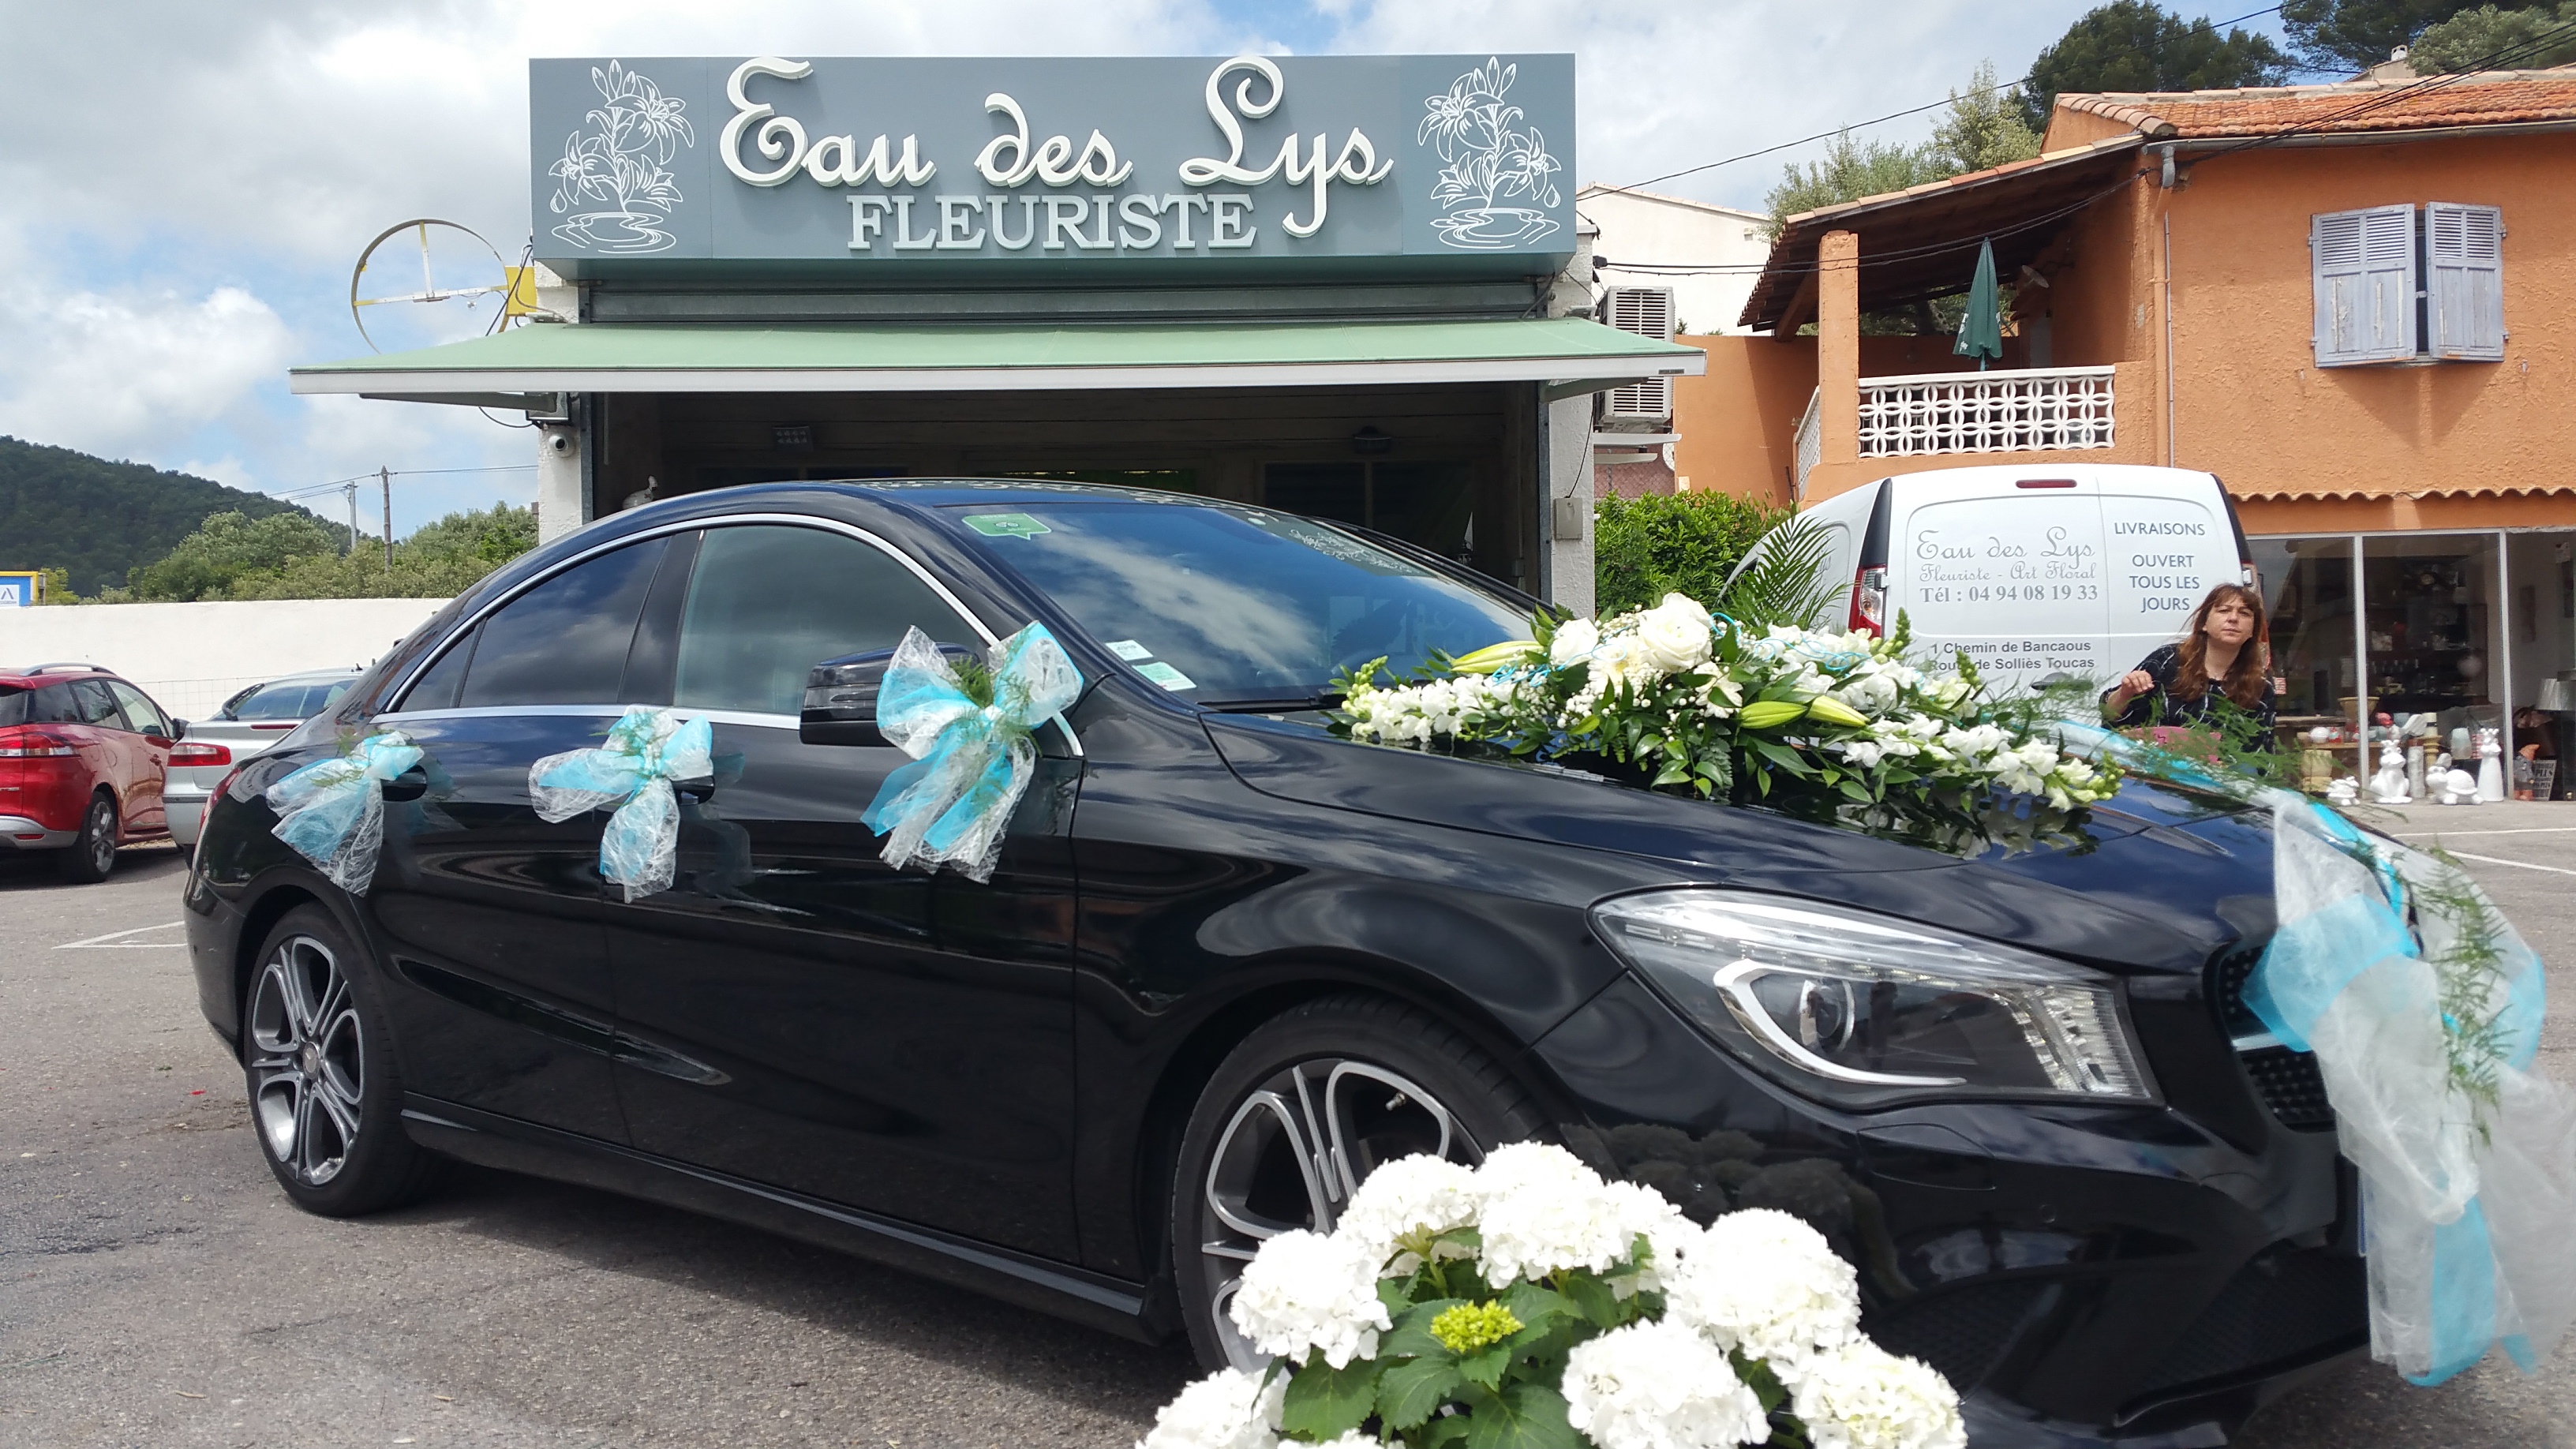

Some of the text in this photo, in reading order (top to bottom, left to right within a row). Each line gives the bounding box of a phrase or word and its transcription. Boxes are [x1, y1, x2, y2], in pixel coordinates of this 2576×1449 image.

[719, 56, 1395, 238] Eau des Lys
[846, 193, 1257, 251] FLEURISTE
[2114, 522, 2206, 536] LIVRAISONS
[1916, 526, 2096, 570] Eau des Lys
[2132, 554, 2195, 567] OUVERT
[1919, 564, 1991, 582] Fleuriste
[2010, 560, 2039, 579] Art
[2045, 561, 2097, 579] Floral
[2129, 575, 2200, 589] TOUS LES
[1919, 587, 1950, 602] Tél
[1968, 586, 1990, 601] 04
[1996, 586, 2018, 601] 94
[2024, 586, 2045, 600] 08
[2052, 585, 2072, 600] 19
[2077, 585, 2098, 600] 33
[2140, 597, 2190, 613] JOURS
[1943, 642, 1997, 653] Chemin
[2001, 642, 2018, 653] de
[2023, 641, 2091, 652] Bancaous
[1995, 657, 2042, 669] Solliès
[2046, 657, 2095, 668] Toucas
